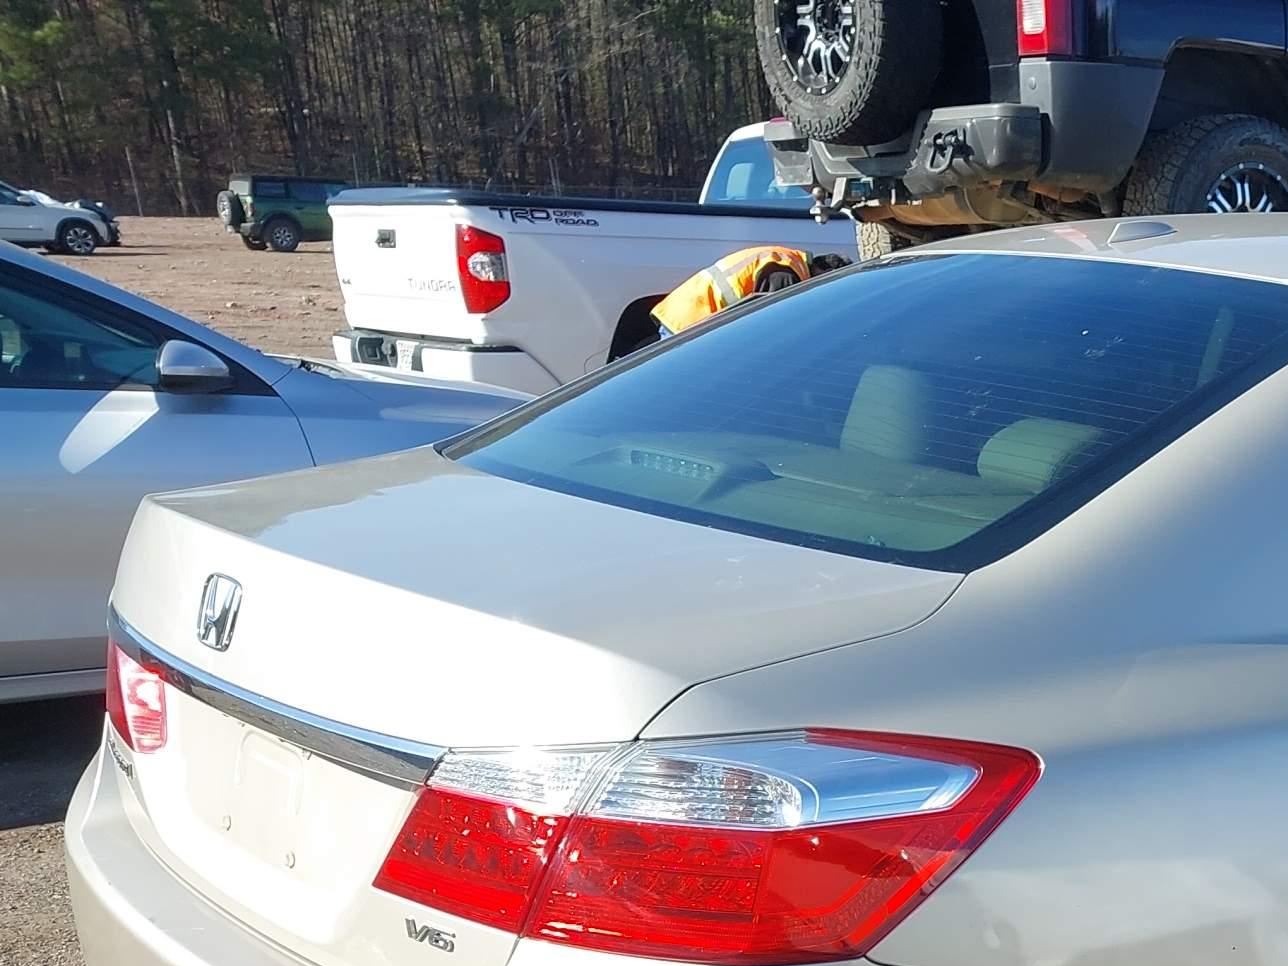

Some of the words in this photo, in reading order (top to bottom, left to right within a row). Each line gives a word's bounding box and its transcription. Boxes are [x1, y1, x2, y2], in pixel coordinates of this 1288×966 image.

[488, 206, 552, 224] TRD
[554, 217, 599, 227] ROAD
[404, 918, 456, 952] V6
